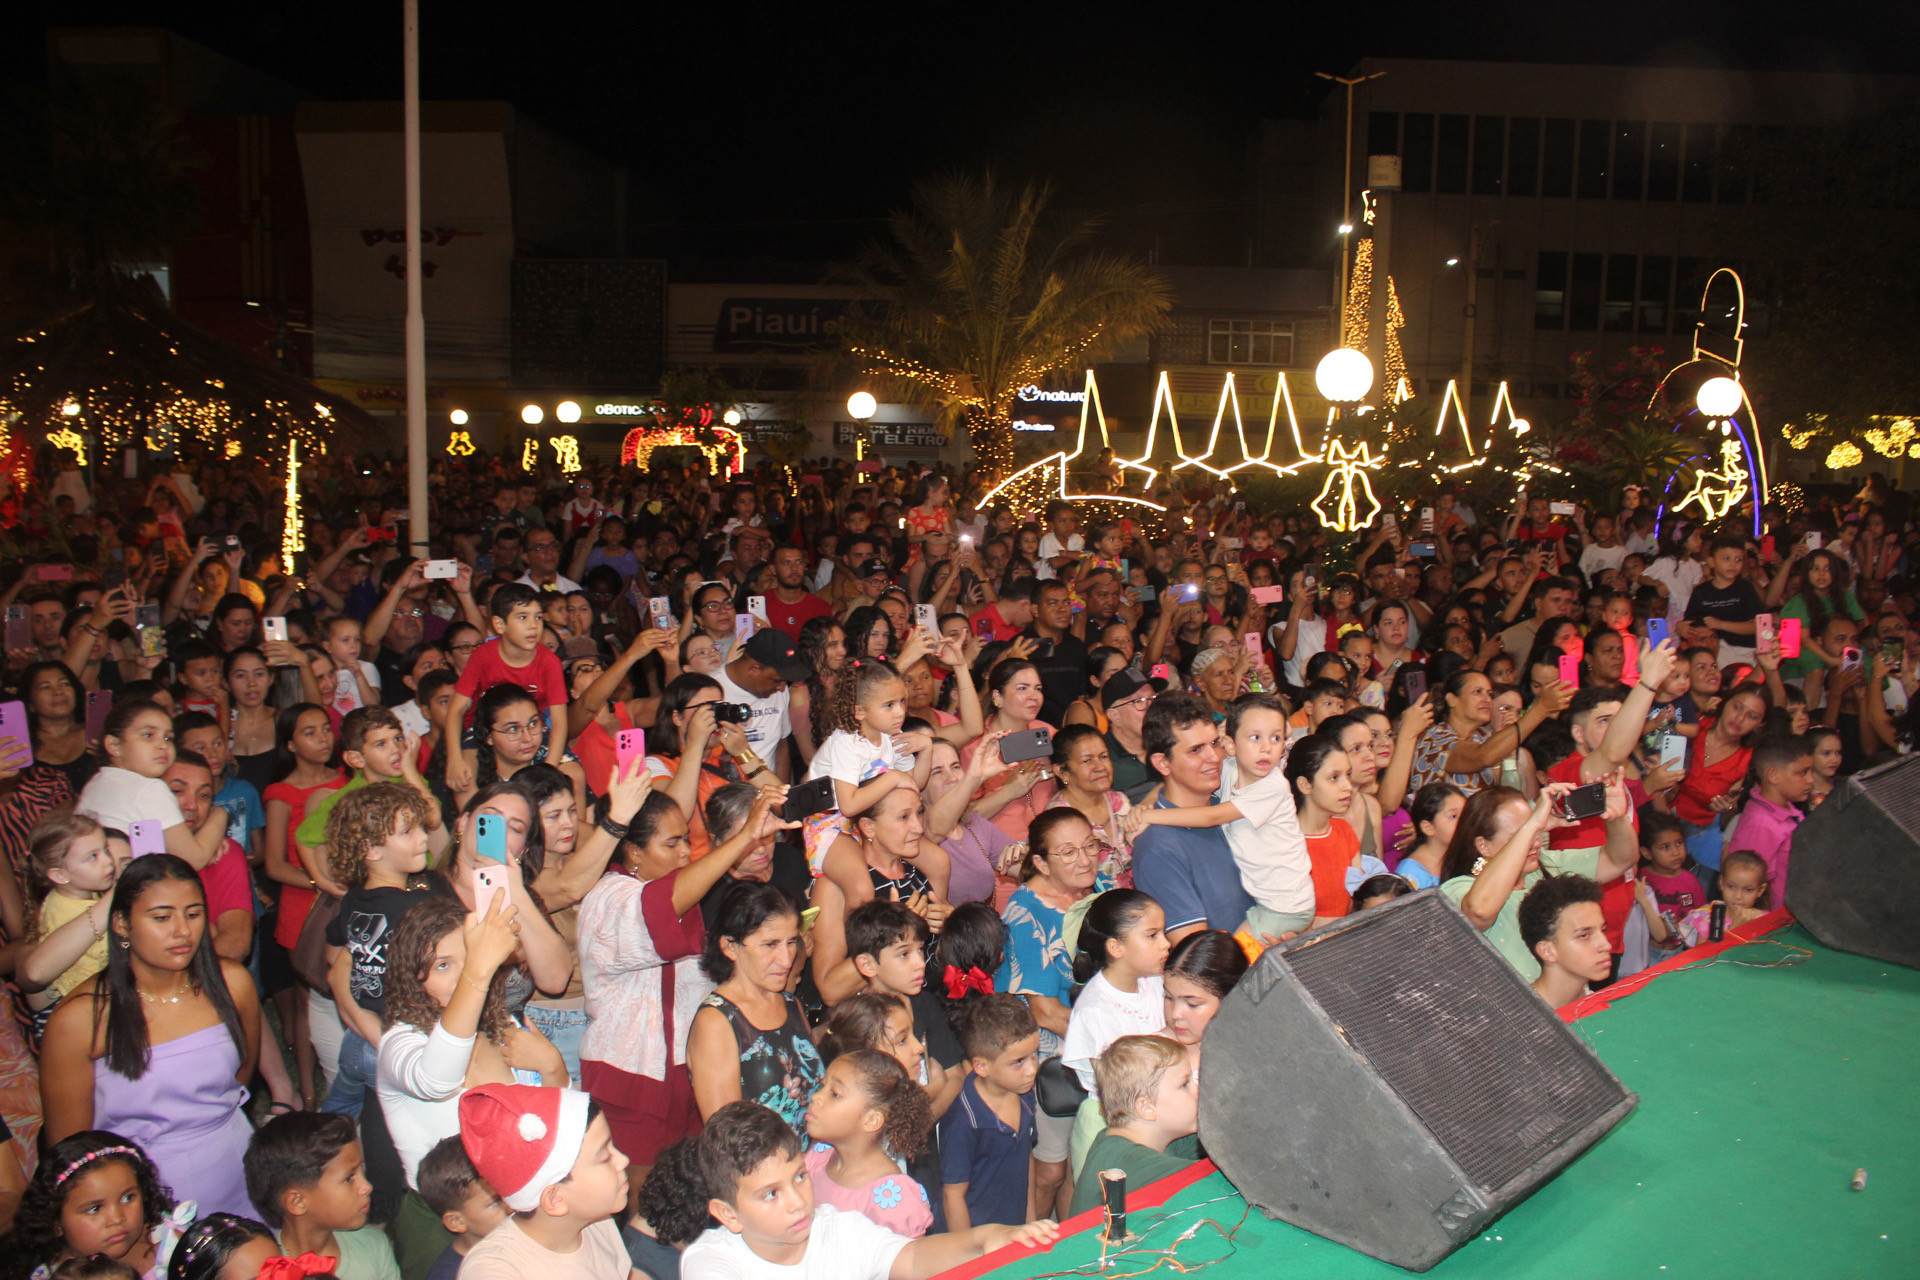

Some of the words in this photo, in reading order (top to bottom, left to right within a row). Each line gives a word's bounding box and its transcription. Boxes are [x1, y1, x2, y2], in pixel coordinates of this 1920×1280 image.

[729, 305, 821, 335] Piauí
[839, 423, 889, 434] BLCK
[884, 434, 945, 446] ELETRO
